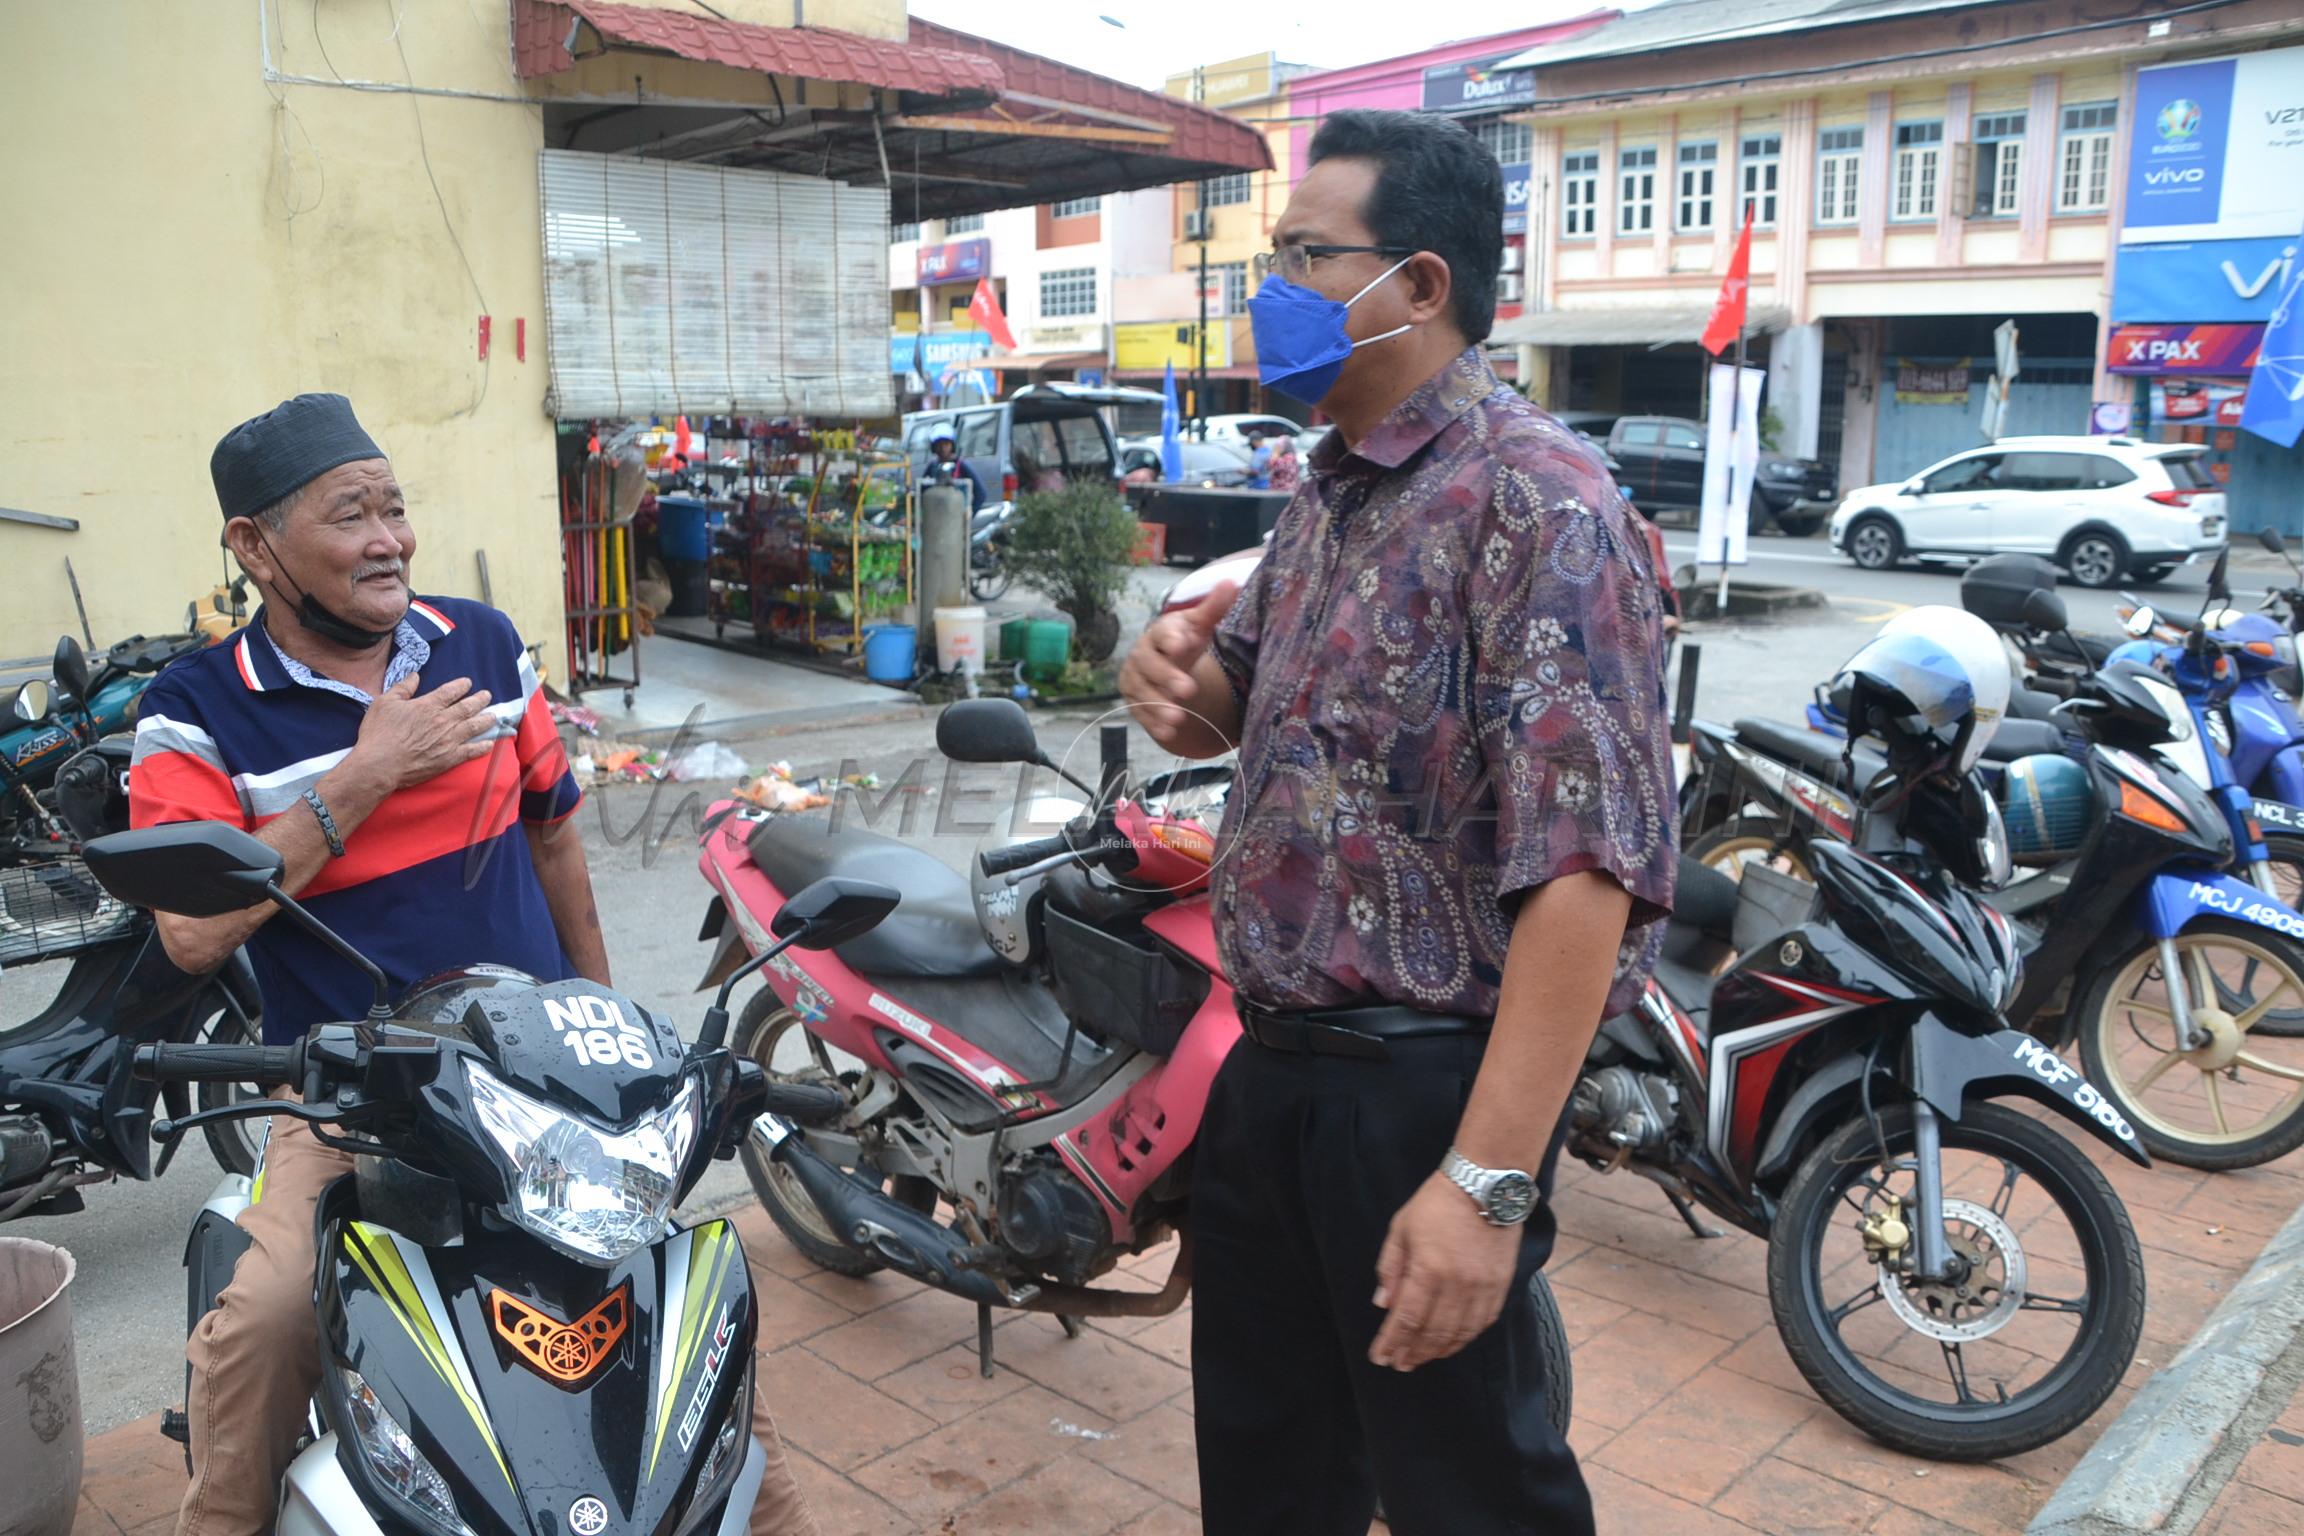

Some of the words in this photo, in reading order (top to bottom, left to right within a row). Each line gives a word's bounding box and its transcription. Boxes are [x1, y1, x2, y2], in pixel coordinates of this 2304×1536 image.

[2143, 166, 2205, 184] vivo
[2126, 340, 2147, 361] X
[2149, 340, 2203, 361] PAX
[2253, 802, 2292, 824] NCL
[2188, 882, 2244, 913] MCJ
[543, 995, 646, 1039] NDL
[868, 993, 933, 1036] SUZUKI
[563, 1029, 653, 1070] 186
[2013, 1038, 2078, 1084] MCF
[2073, 1082, 2136, 1141] 5160
